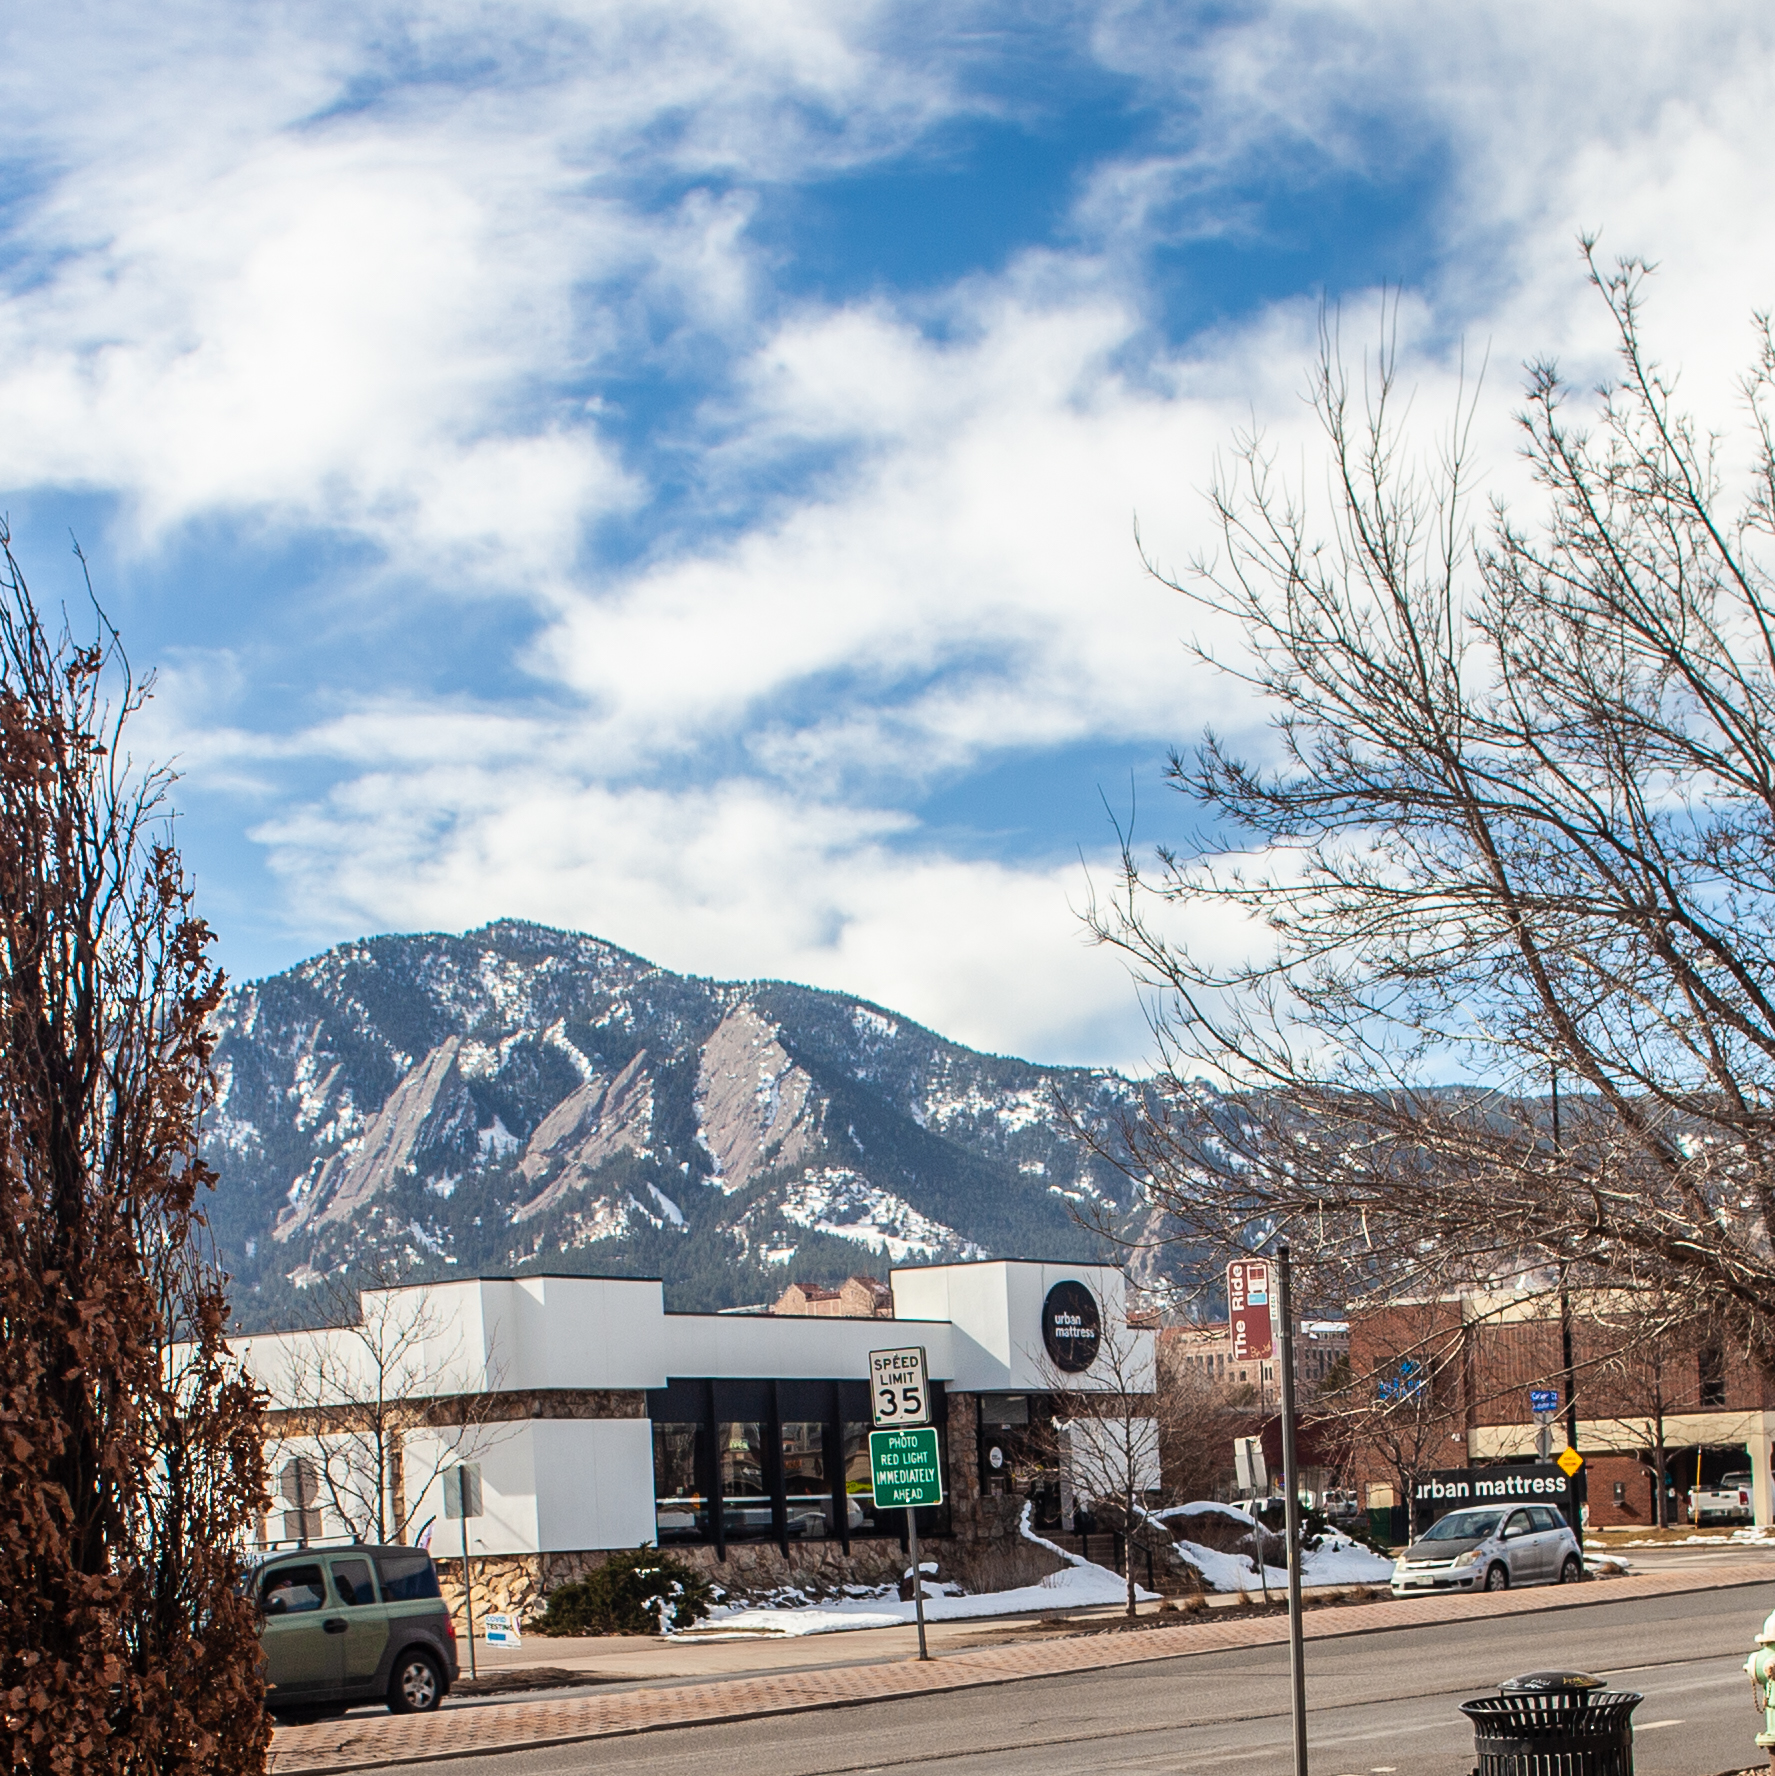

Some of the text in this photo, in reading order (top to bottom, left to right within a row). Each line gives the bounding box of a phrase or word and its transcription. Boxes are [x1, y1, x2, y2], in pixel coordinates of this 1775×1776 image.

[1054, 1312, 1081, 1325] urban
[1231, 1265, 1248, 1358] The Ride
[1055, 1325, 1095, 1338] mattress
[874, 1355, 919, 1371] SPEED
[880, 1371, 915, 1386] LIMIT
[879, 1386, 922, 1416] 35
[888, 1436, 918, 1449] PHOTO
[881, 1451, 928, 1466] RED LIGHT
[876, 1468, 935, 1485] IMMEDIATELY
[1475, 1475, 1567, 1495] mattress
[893, 1487, 923, 1501] AHEAD
[486, 1615, 506, 1623] COVID
[486, 1623, 513, 1631] TESTING
